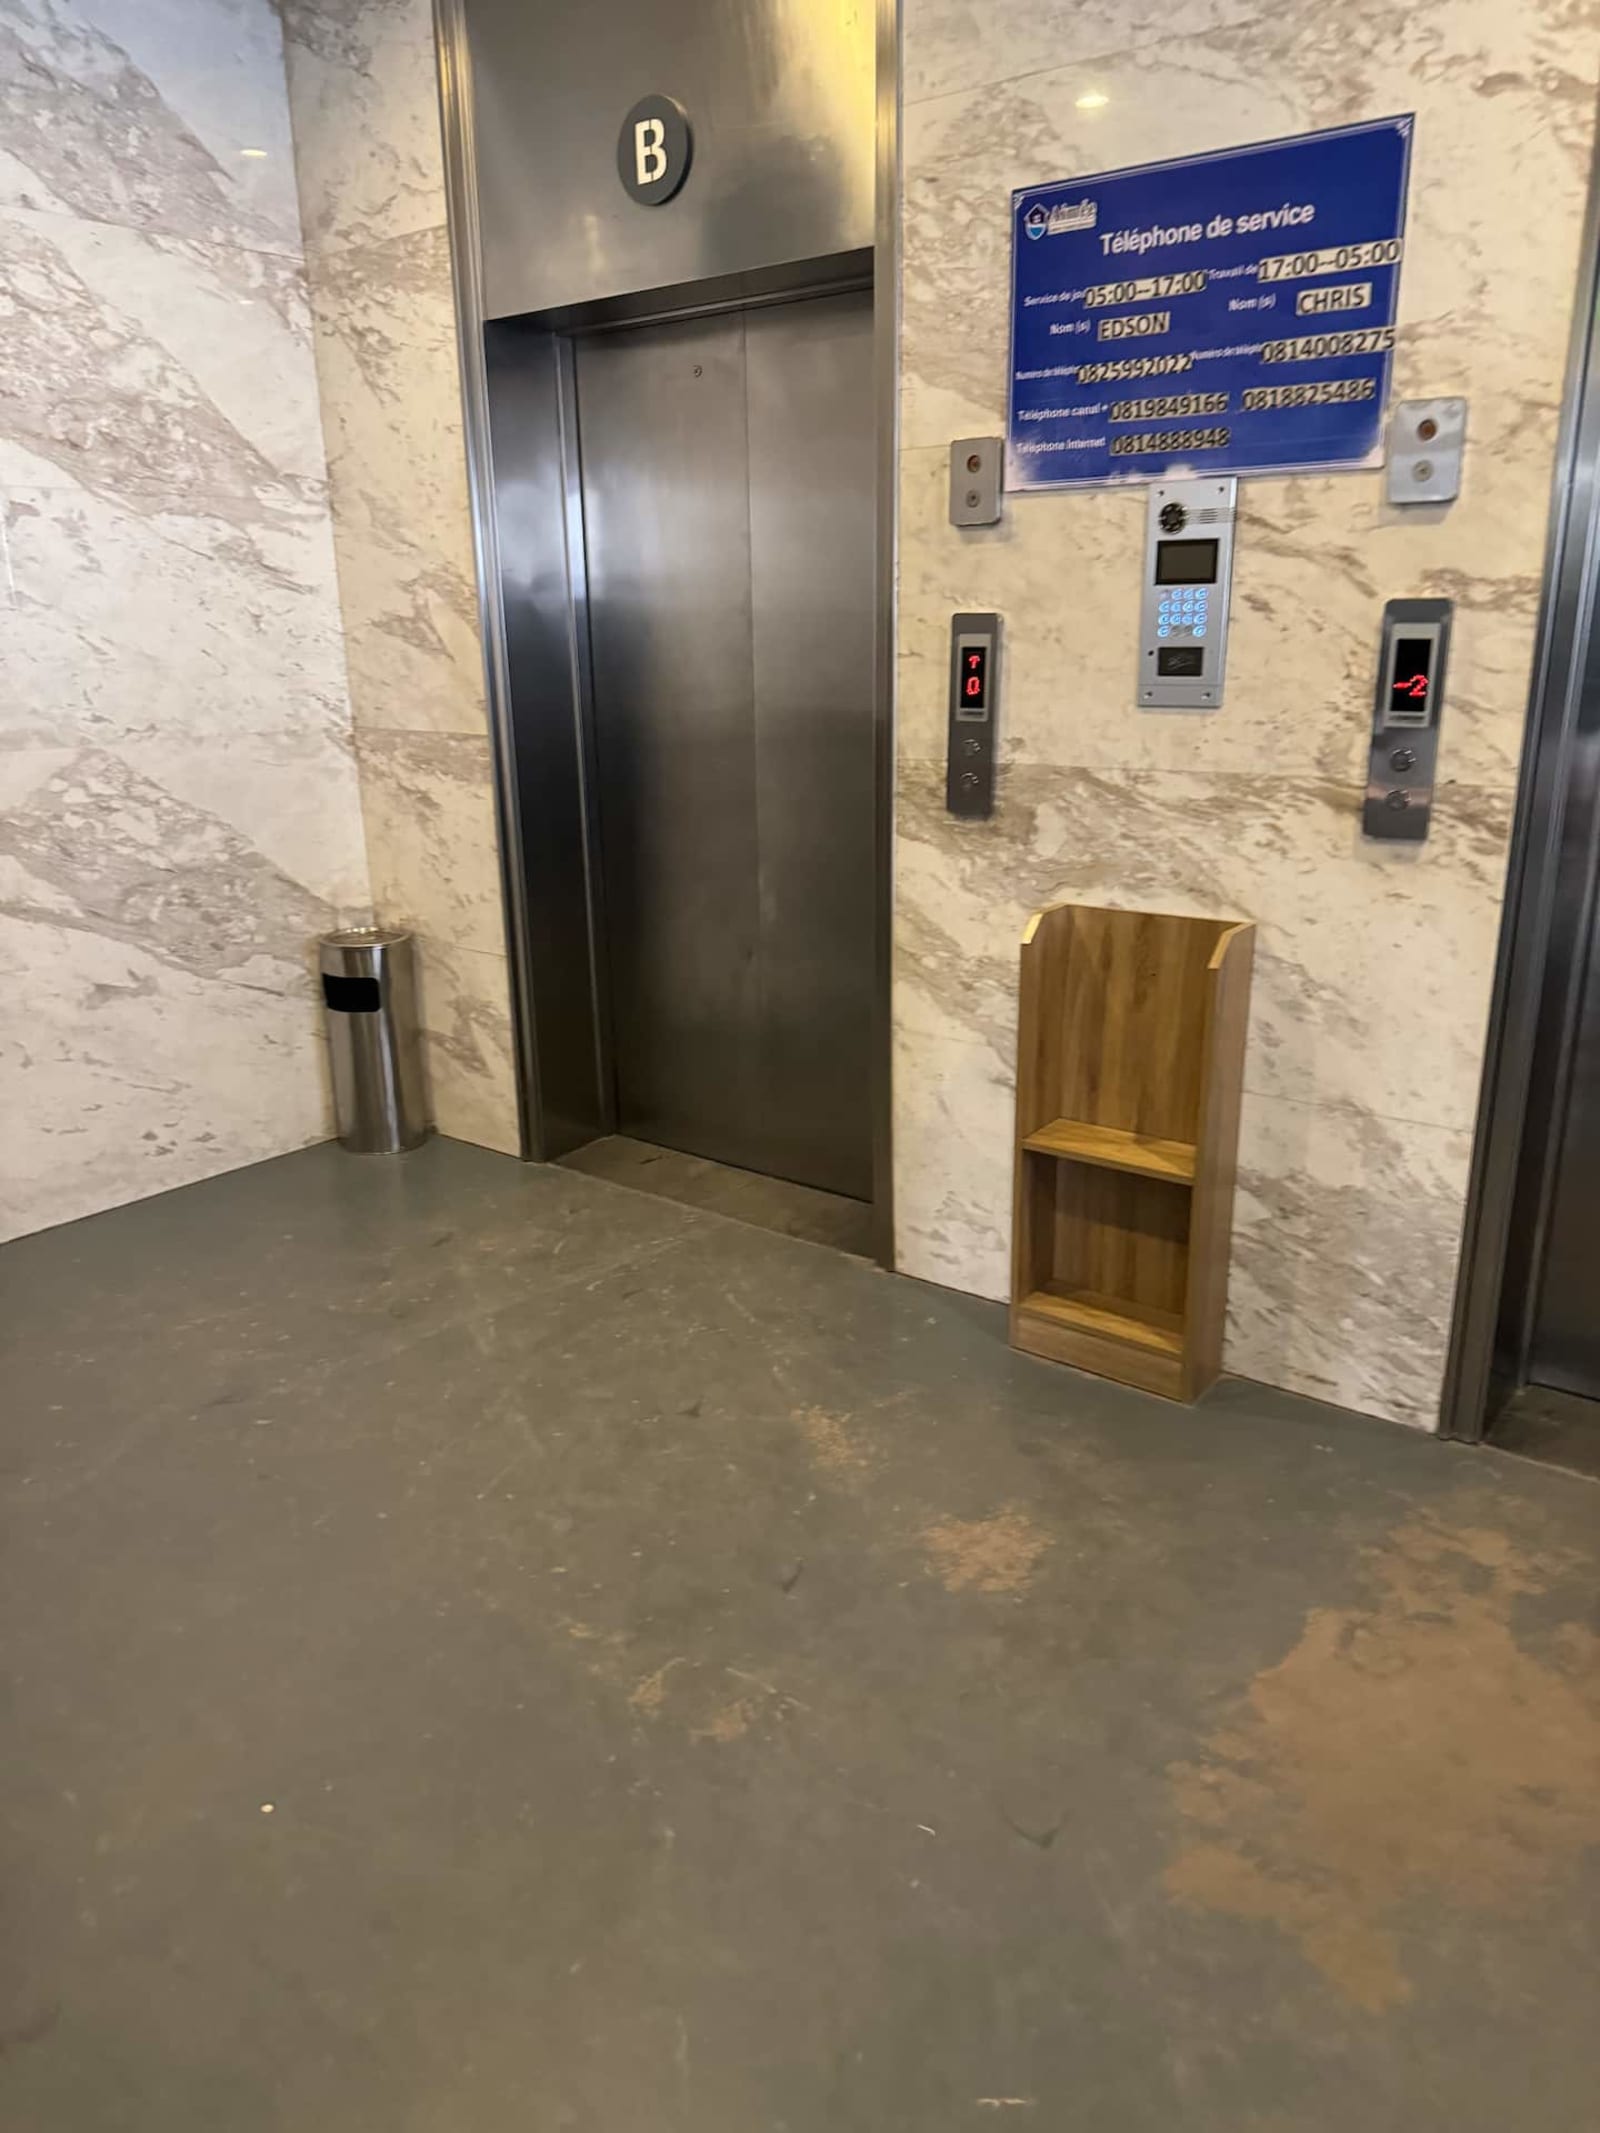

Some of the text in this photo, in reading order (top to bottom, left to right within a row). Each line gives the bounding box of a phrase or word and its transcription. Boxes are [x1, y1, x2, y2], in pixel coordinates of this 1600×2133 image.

[635, 118, 668, 185] B
[1099, 212, 1202, 256] Téléphone
[1206, 213, 1233, 240] de
[1235, 203, 1316, 234] service
[1300, 286, 1365, 314] CHRIS
[1101, 314, 1167, 340] EDSON
[1262, 328, 1396, 363] 0814008275
[966, 676, 980, 695] 0
